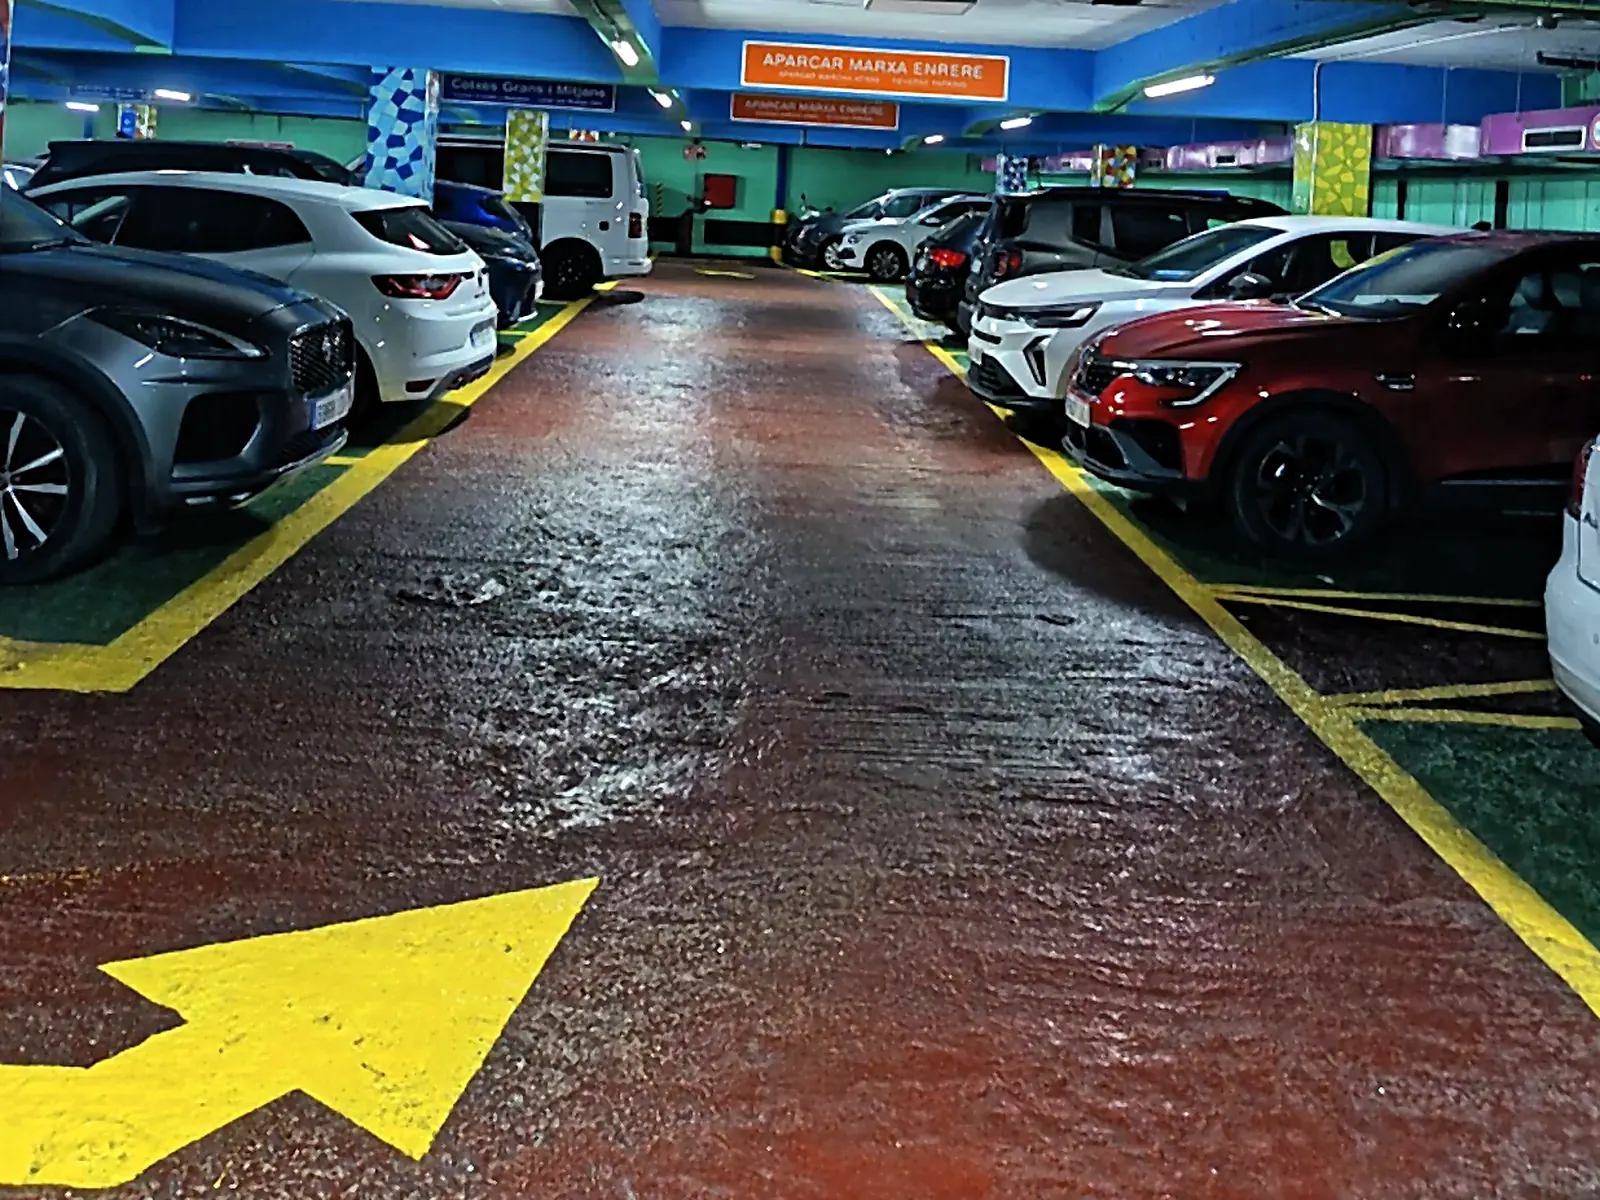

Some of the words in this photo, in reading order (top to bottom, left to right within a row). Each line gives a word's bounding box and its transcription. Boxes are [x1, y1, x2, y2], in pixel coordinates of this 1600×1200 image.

[762, 52, 843, 70] APARCAR
[849, 57, 908, 75] MARXA
[913, 61, 984, 80] ENRERE
[502, 81, 543, 95] Grans
